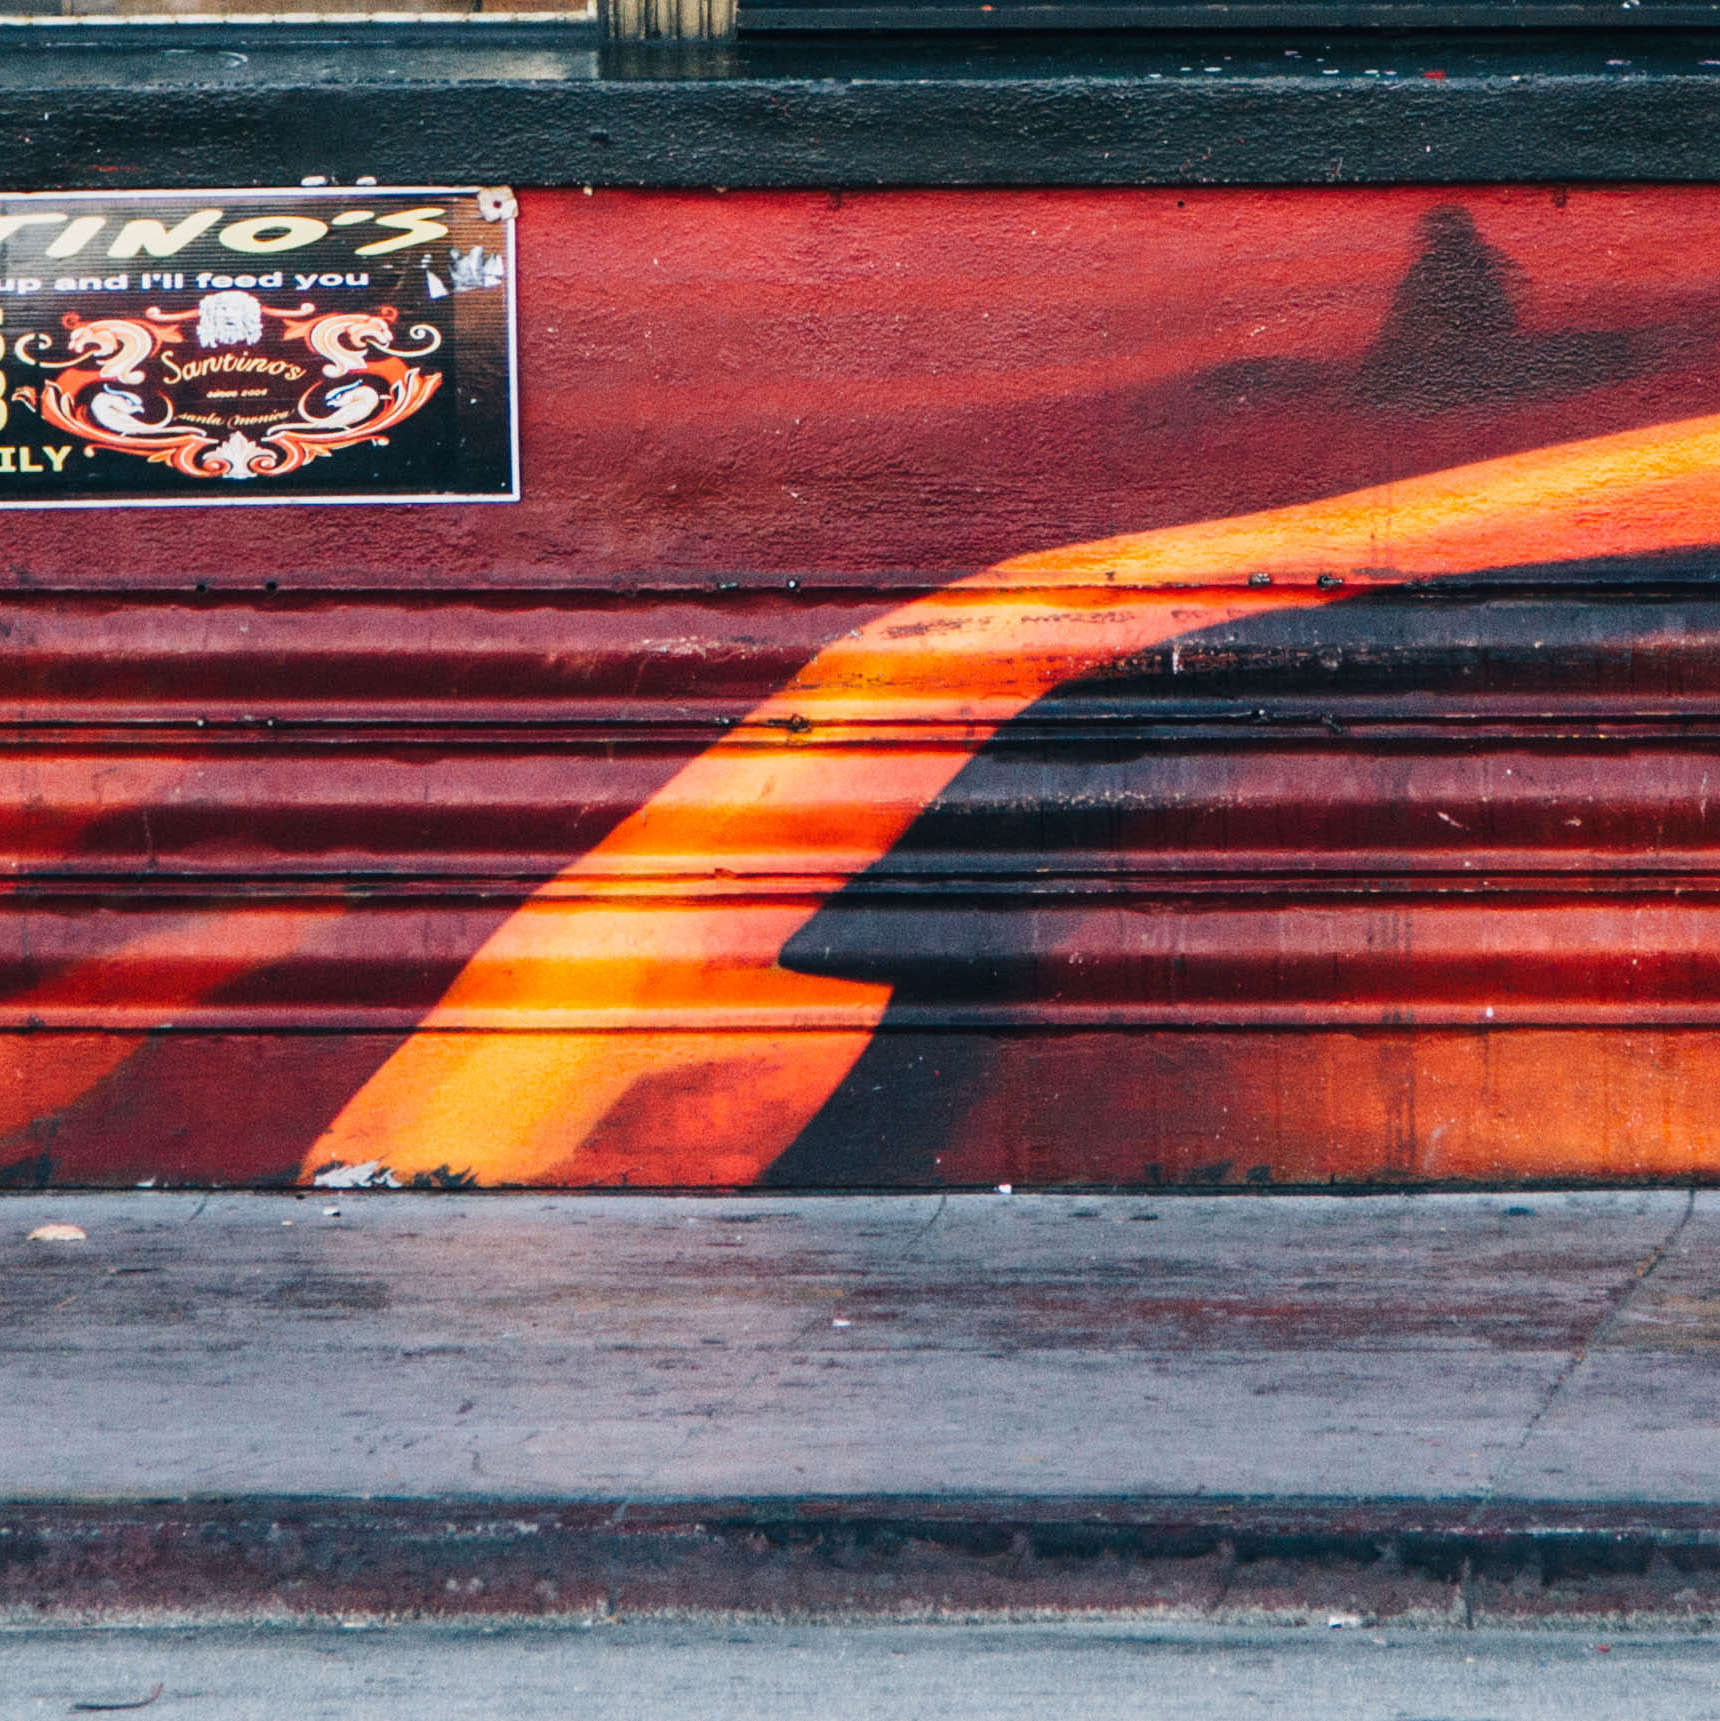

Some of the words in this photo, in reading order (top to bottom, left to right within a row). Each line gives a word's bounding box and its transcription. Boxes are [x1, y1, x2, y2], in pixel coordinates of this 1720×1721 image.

[54, 272, 128, 292] and
[141, 271, 184, 291] I'll
[195, 270, 284, 291] feed
[294, 271, 370, 292] you
